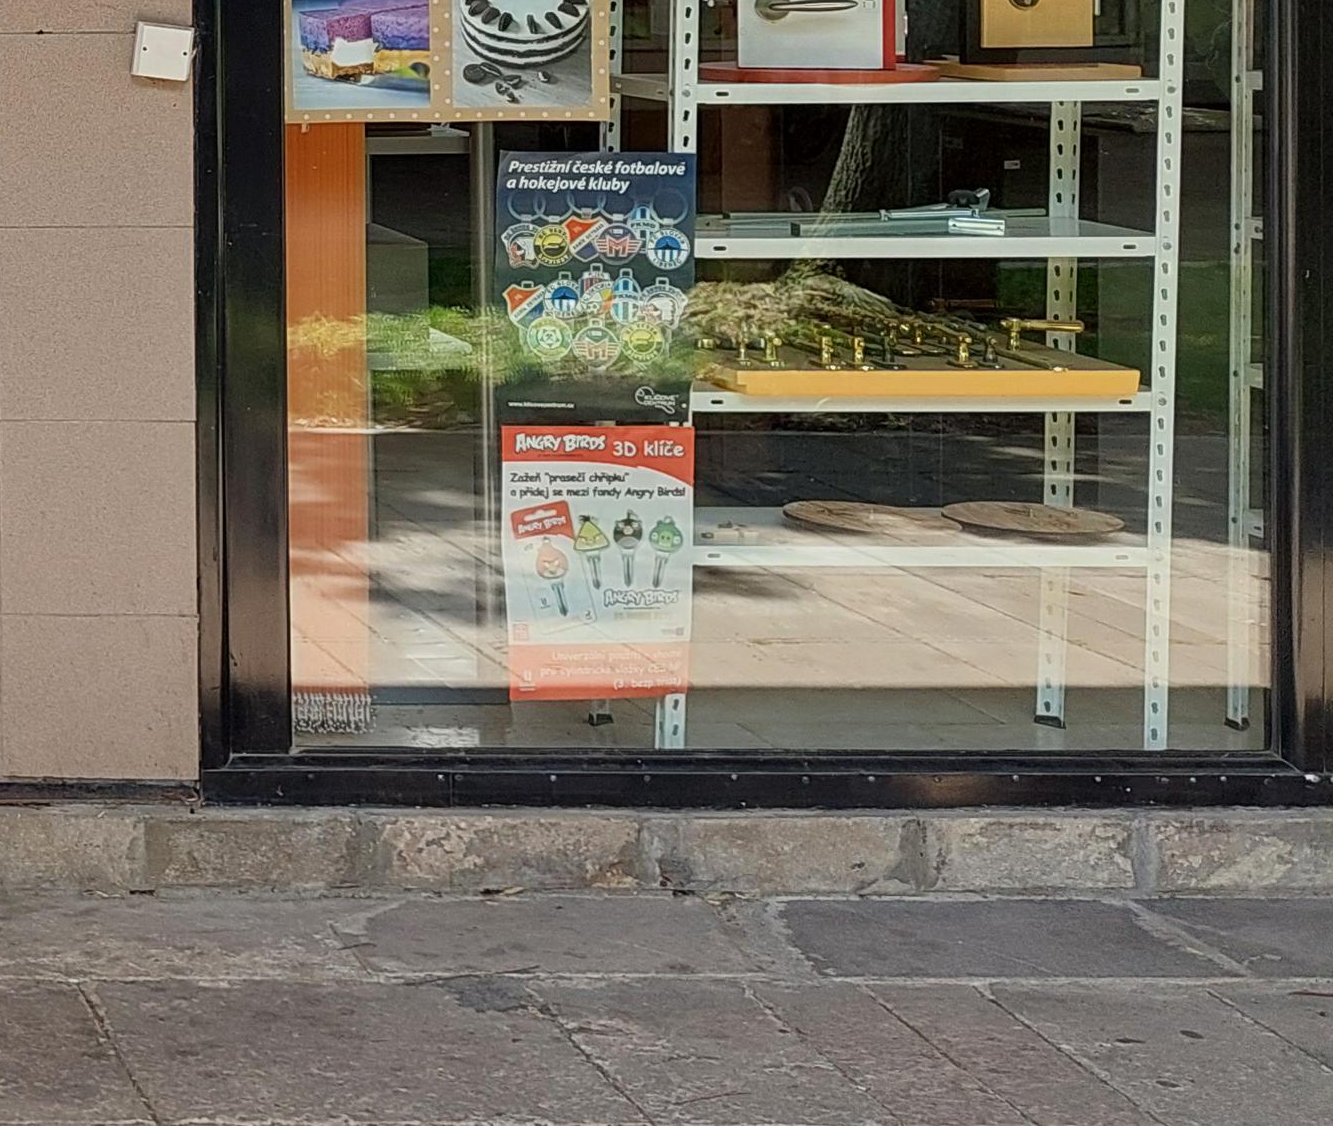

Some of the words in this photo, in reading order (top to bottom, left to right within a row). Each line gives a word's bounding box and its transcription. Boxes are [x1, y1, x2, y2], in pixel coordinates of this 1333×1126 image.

[508, 160, 573, 174] Prestižní
[573, 160, 612, 174] české
[614, 161, 686, 175] fotbalové
[506, 178, 516, 189] a
[519, 176, 586, 193] hokejové
[588, 177, 630, 194] kluby
[515, 433, 561, 454] ANGRY
[563, 434, 607, 452] BIRDS
[612, 441, 637, 458] 3D
[643, 439, 685, 458] klíče
[510, 489, 517, 497] a
[519, 487, 550, 500] přidej
[552, 489, 563, 497] se
[566, 488, 590, 497] mezi
[593, 487, 621, 500] fandy
[625, 487, 655, 500] Angry
[657, 487, 686, 497] Birds!
[604, 588, 642, 607] ANGRY
[643, 588, 680, 606] BIRDS
